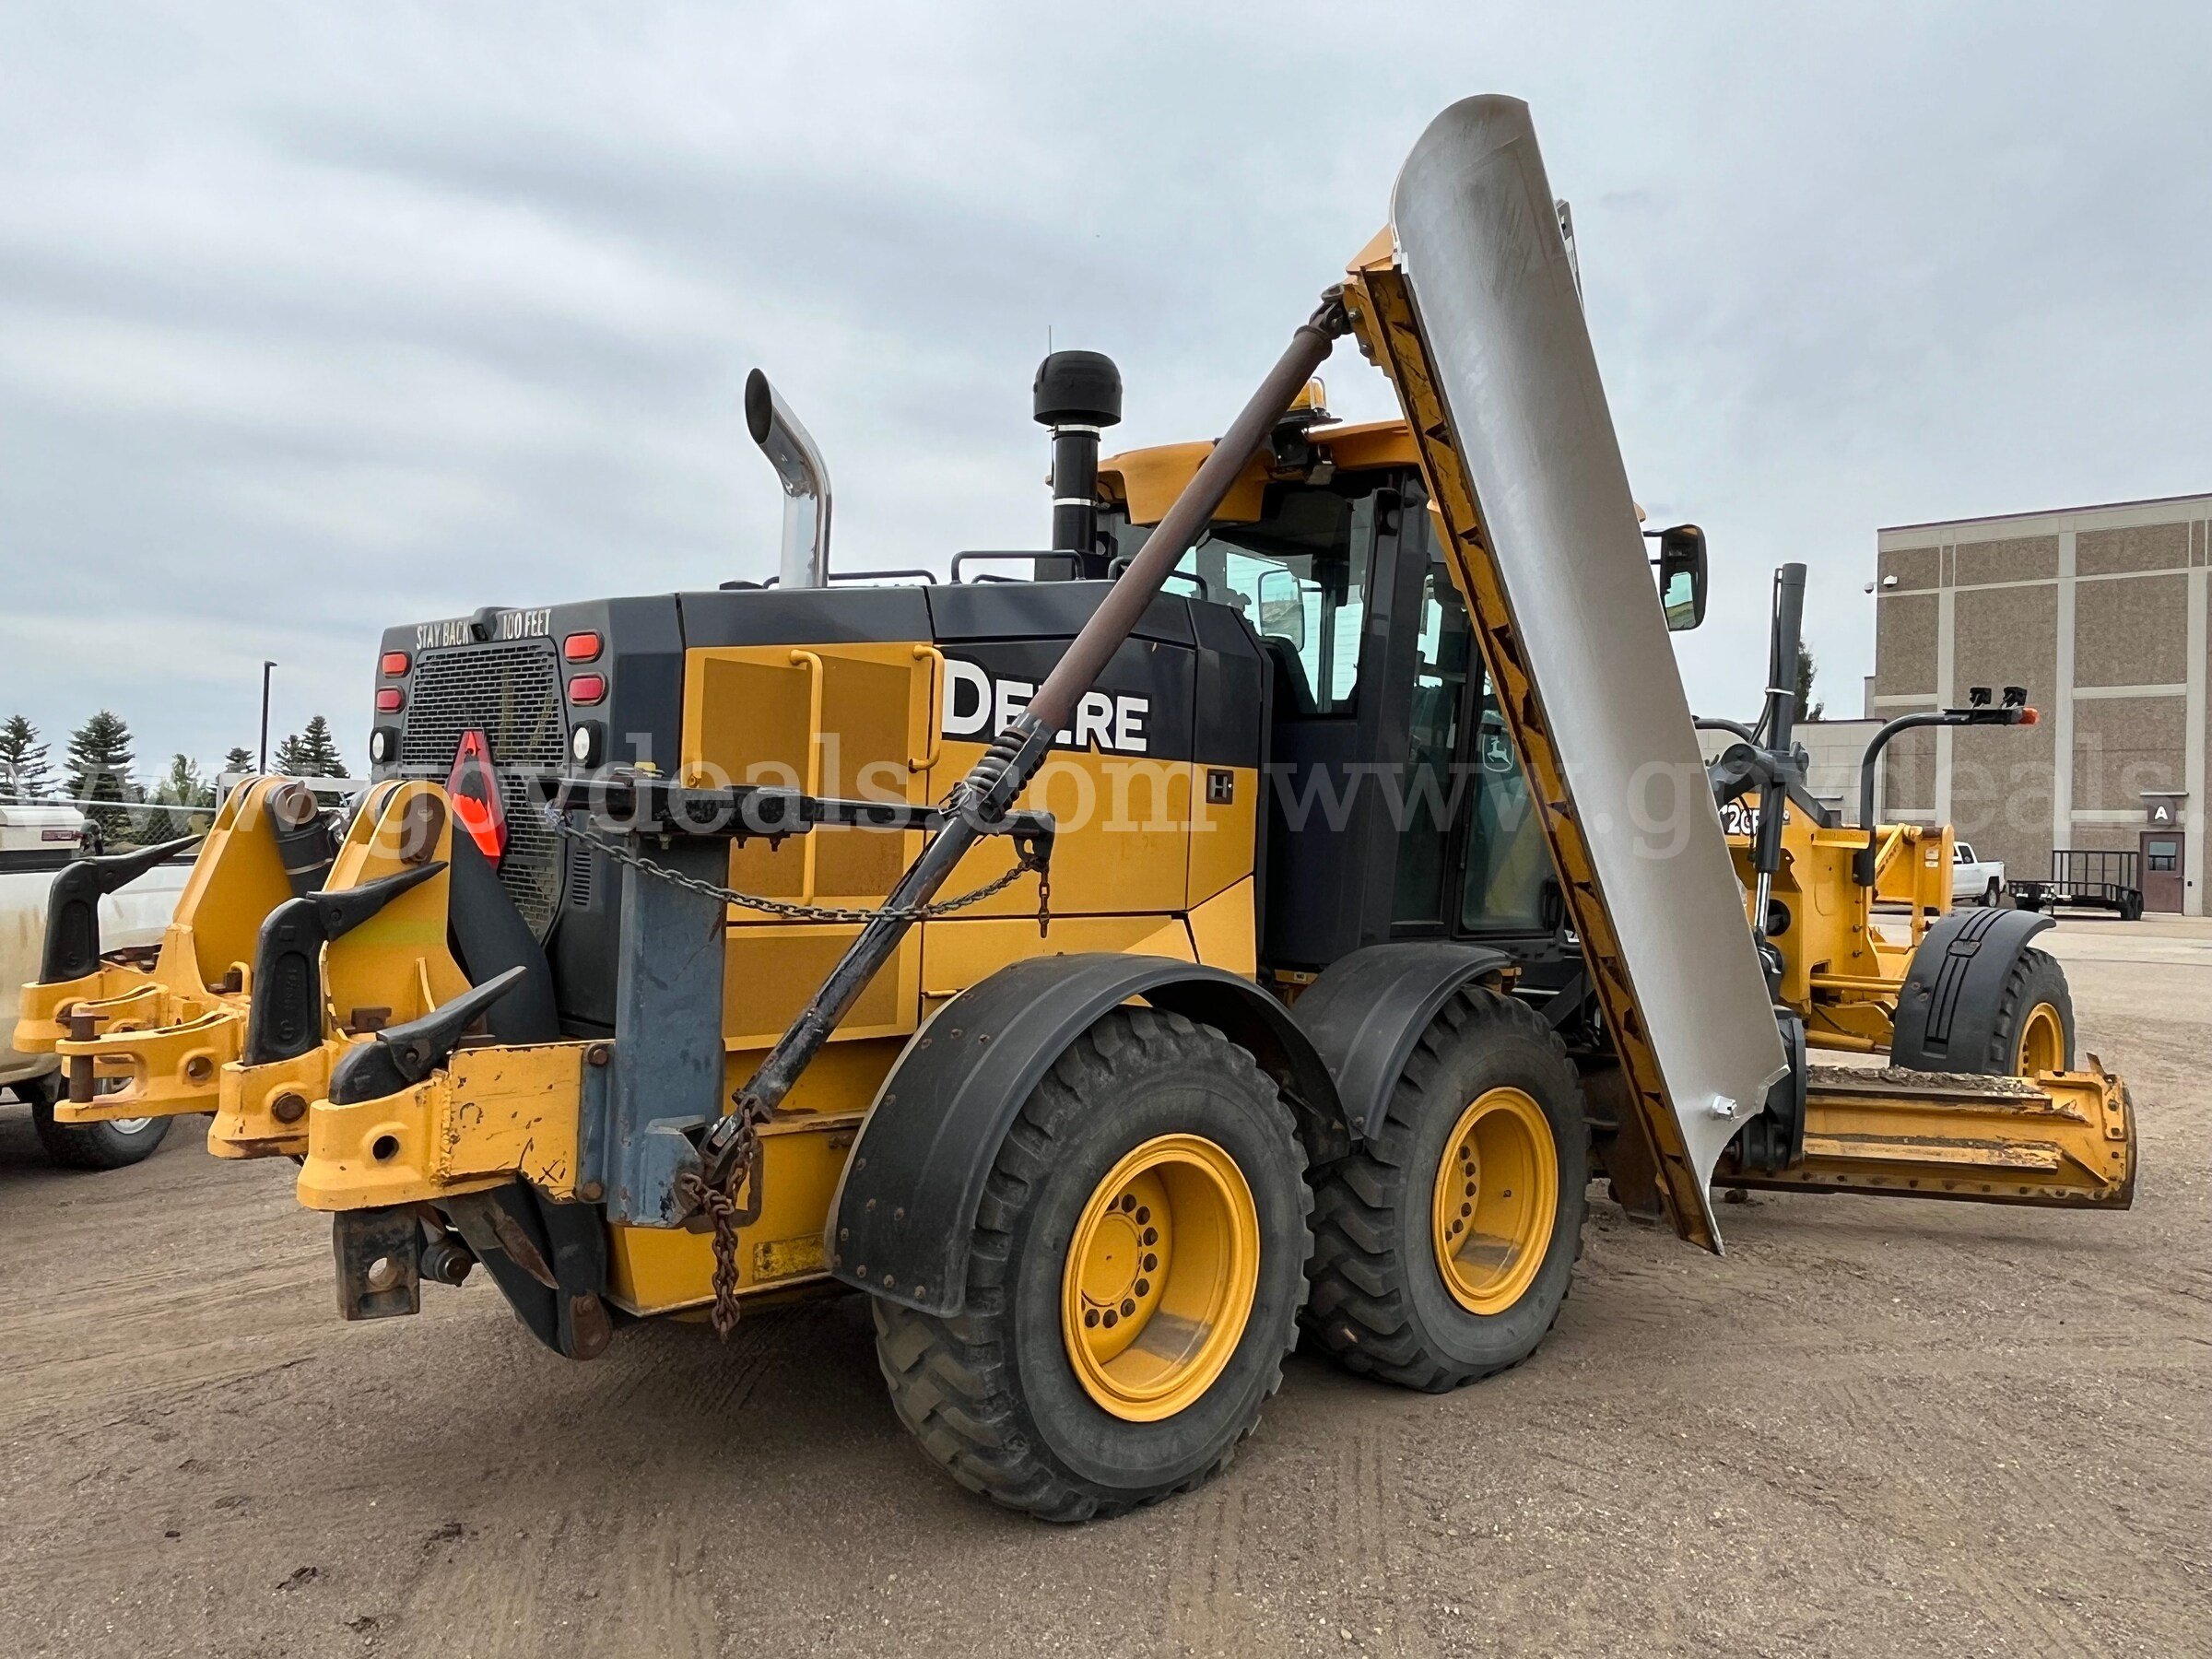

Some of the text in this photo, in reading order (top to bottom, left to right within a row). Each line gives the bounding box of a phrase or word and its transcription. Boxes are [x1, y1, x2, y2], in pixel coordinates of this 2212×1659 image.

[417, 608, 551, 650] STAY BACK 100 FEET
[942, 658, 1149, 752] DERE
[2154, 806, 2169, 819] A
